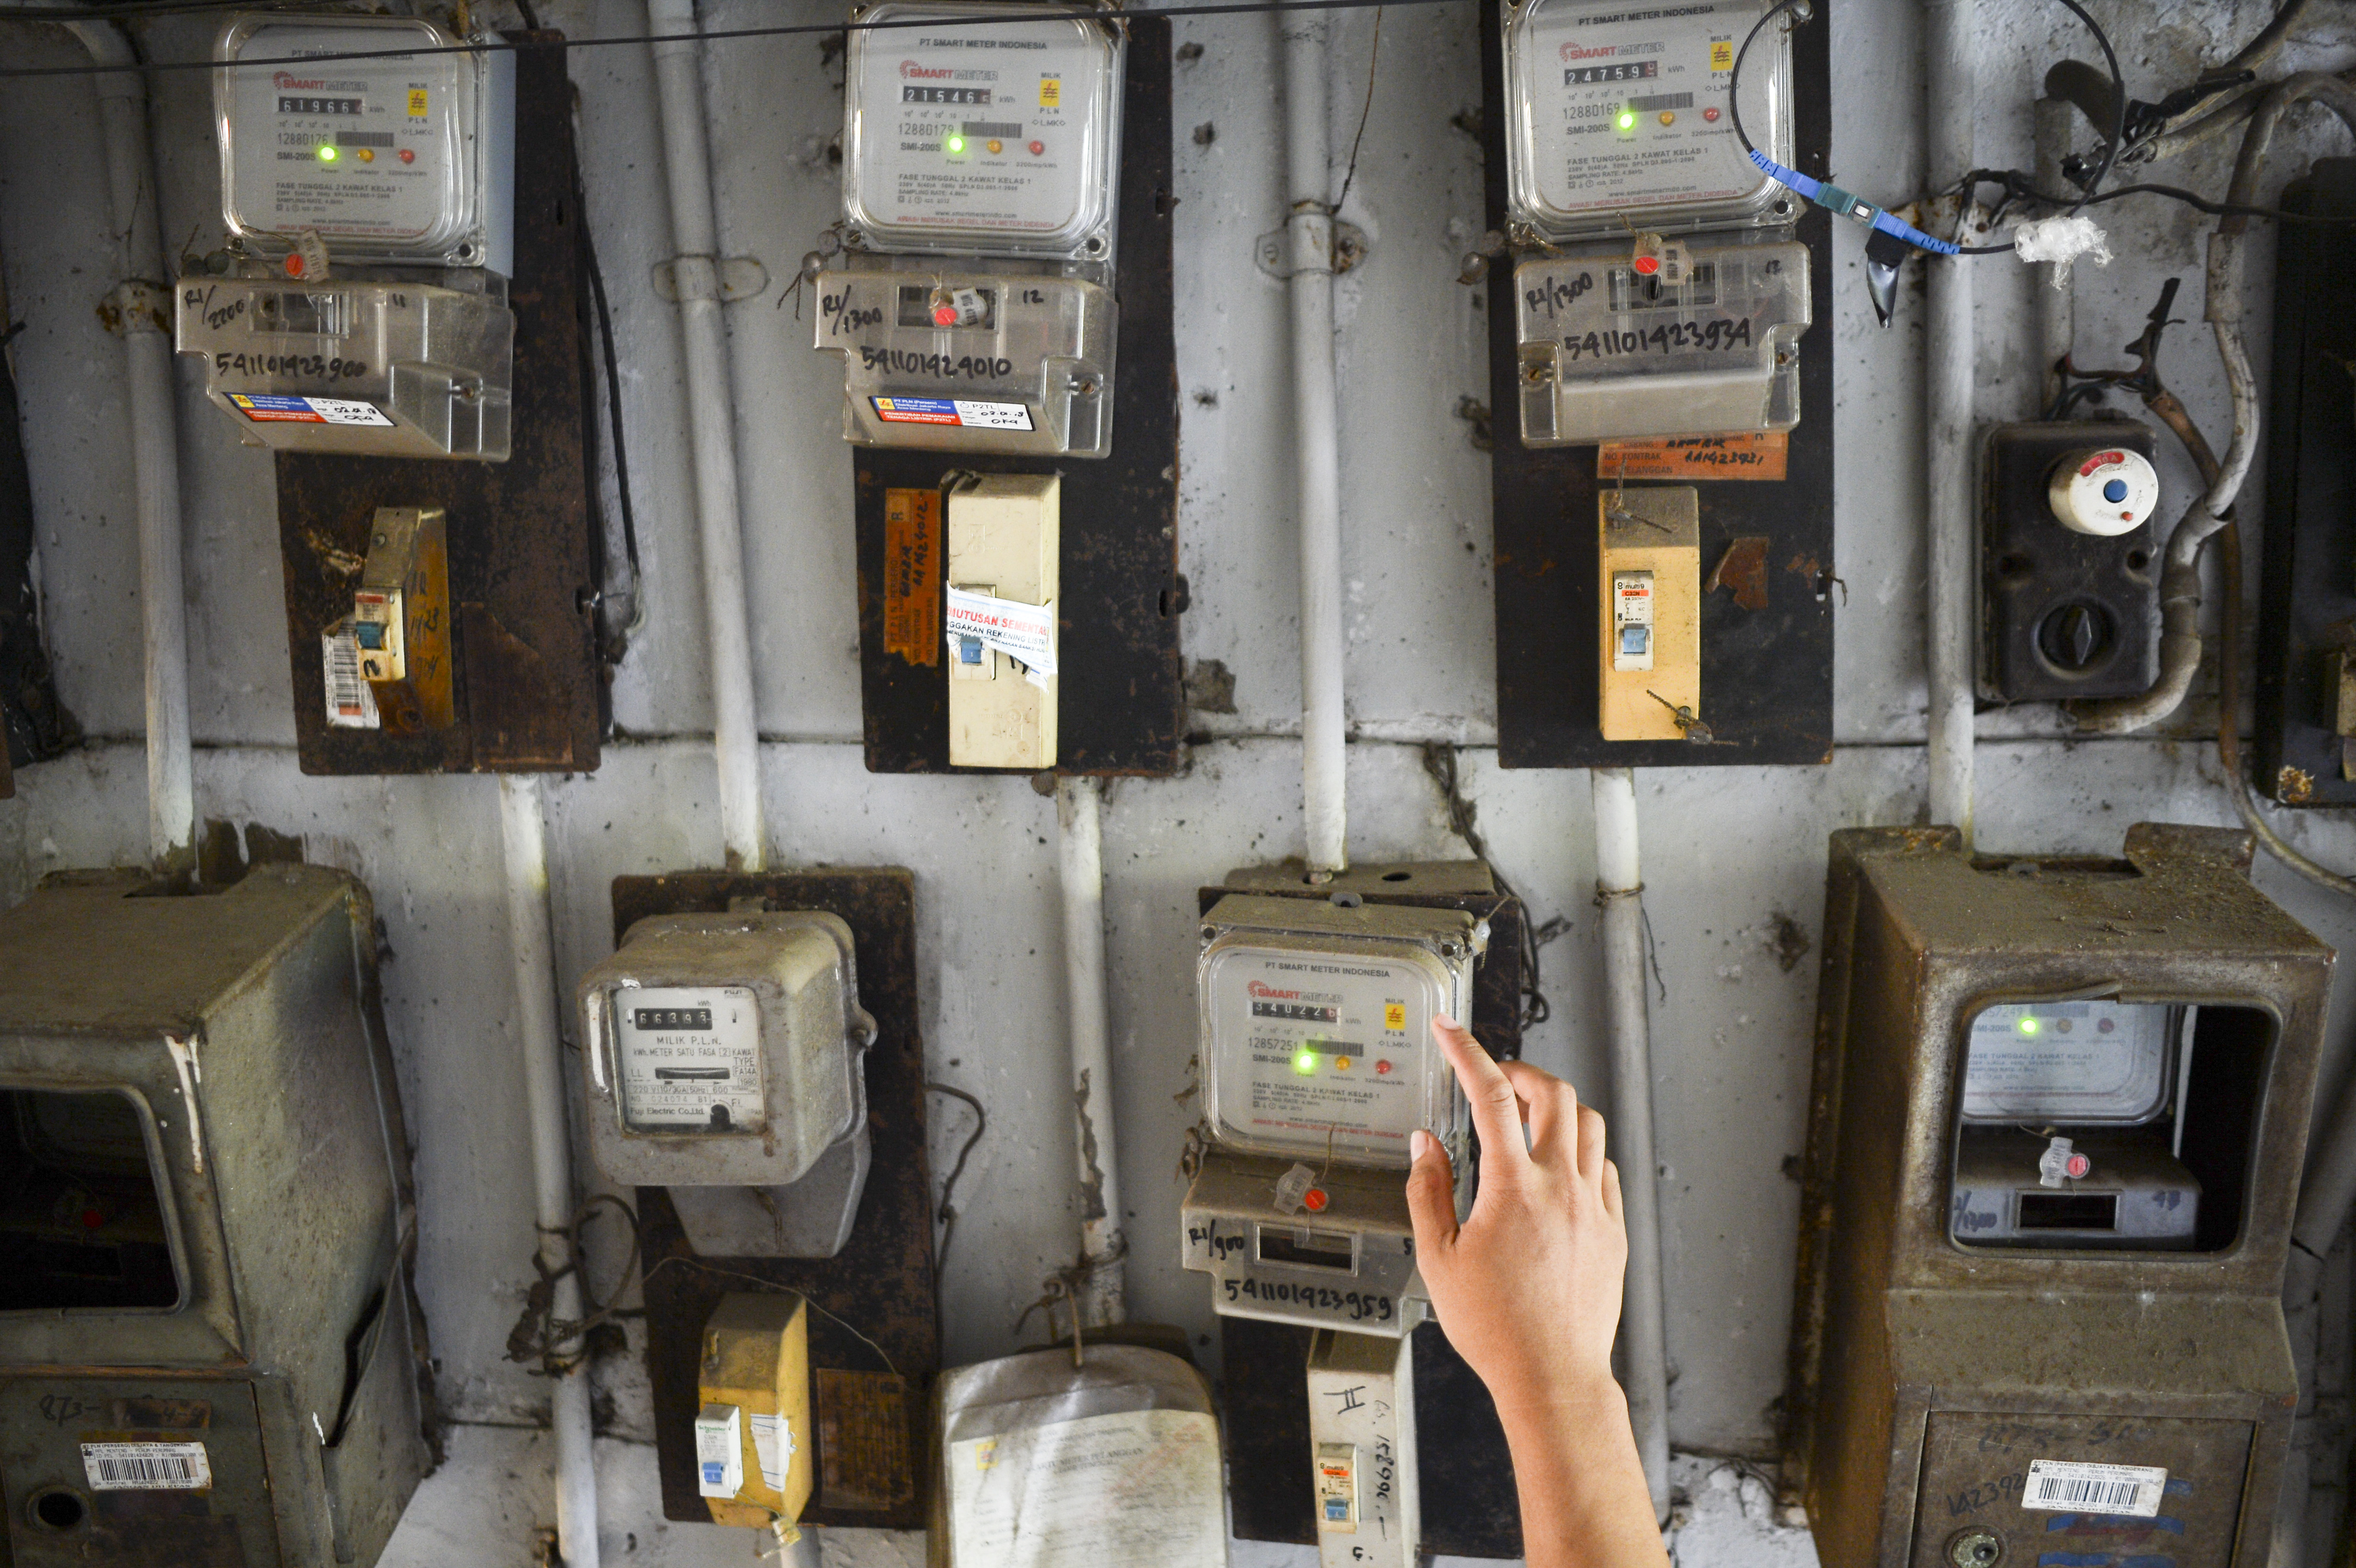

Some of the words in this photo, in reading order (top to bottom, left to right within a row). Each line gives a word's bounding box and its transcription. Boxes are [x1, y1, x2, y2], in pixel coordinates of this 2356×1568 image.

[1593, 14, 1625, 24] SMART
[1629, 11, 1660, 21] METER
[1663, 5, 1714, 17] INDONESIA
[934, 39, 964, 47] SMART
[999, 41, 1047, 49] INDONESIA
[1571, 47, 1617, 59] SMART
[1619, 42, 1665, 55] METER
[909, 69, 954, 78] SMART
[955, 70, 998, 81] METER
[283, 80, 325, 89] SMART
[1567, 124, 1610, 135] SMI-200S
[901, 143, 941, 151] SMI-200S
[277, 152, 316, 161] SMI-200S
[1592, 154, 1631, 164] TUNGGAL
[1642, 150, 1670, 158] KAWAT
[1673, 148, 1701, 156] KELAS
[987, 628, 1023, 642] REKENING
[1279, 962, 1307, 971] SMART
[1311, 965, 1340, 973] METER
[1342, 967, 1390, 977] INDONESIA
[1258, 988, 1301, 999] SMART
[734, 1057, 755, 1066] TYPE
[1253, 1054, 1291, 1064] SMI-200S
